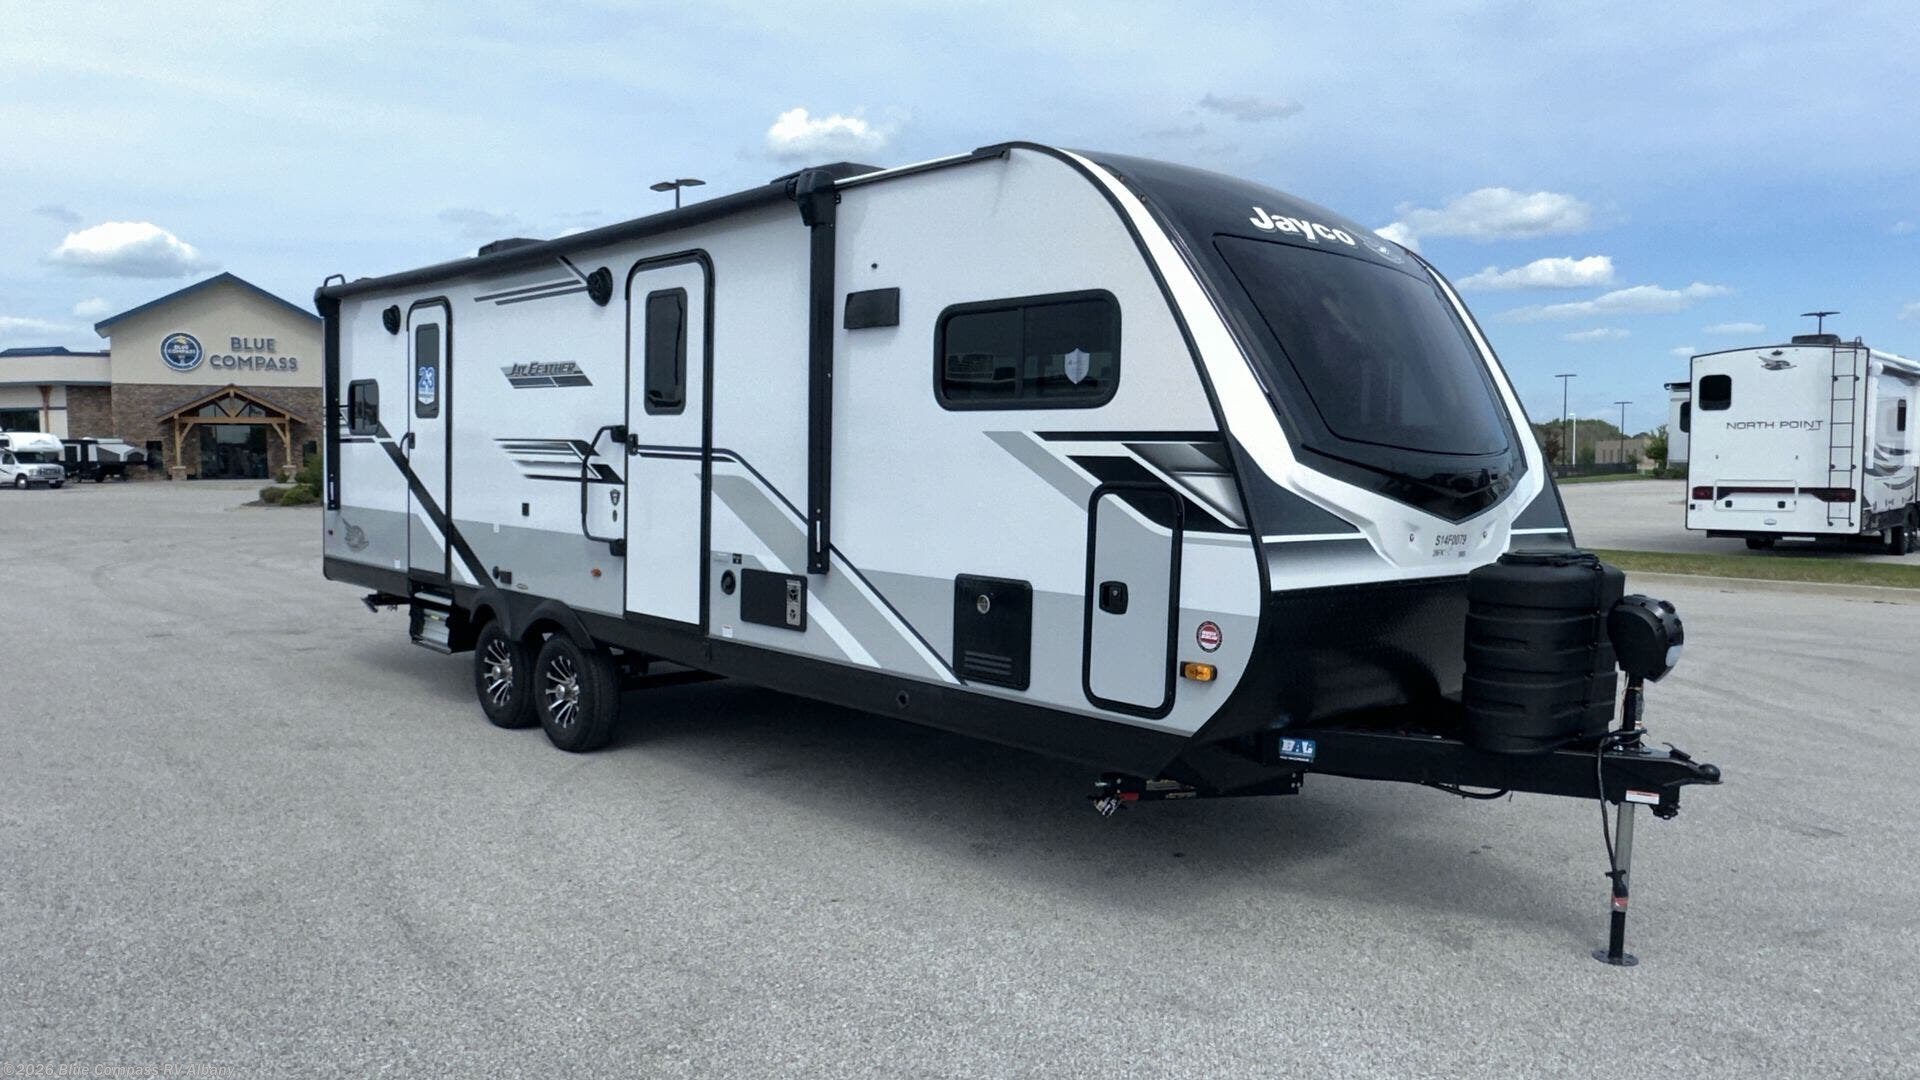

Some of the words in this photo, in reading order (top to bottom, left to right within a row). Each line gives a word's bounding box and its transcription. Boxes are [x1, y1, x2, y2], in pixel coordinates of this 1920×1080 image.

[1249, 206, 1356, 247] Jayco
[230, 337, 276, 352] BLUE
[209, 354, 299, 372] COMPASS
[1726, 421, 1775, 430] NORTH
[1779, 420, 1824, 430] POINT
